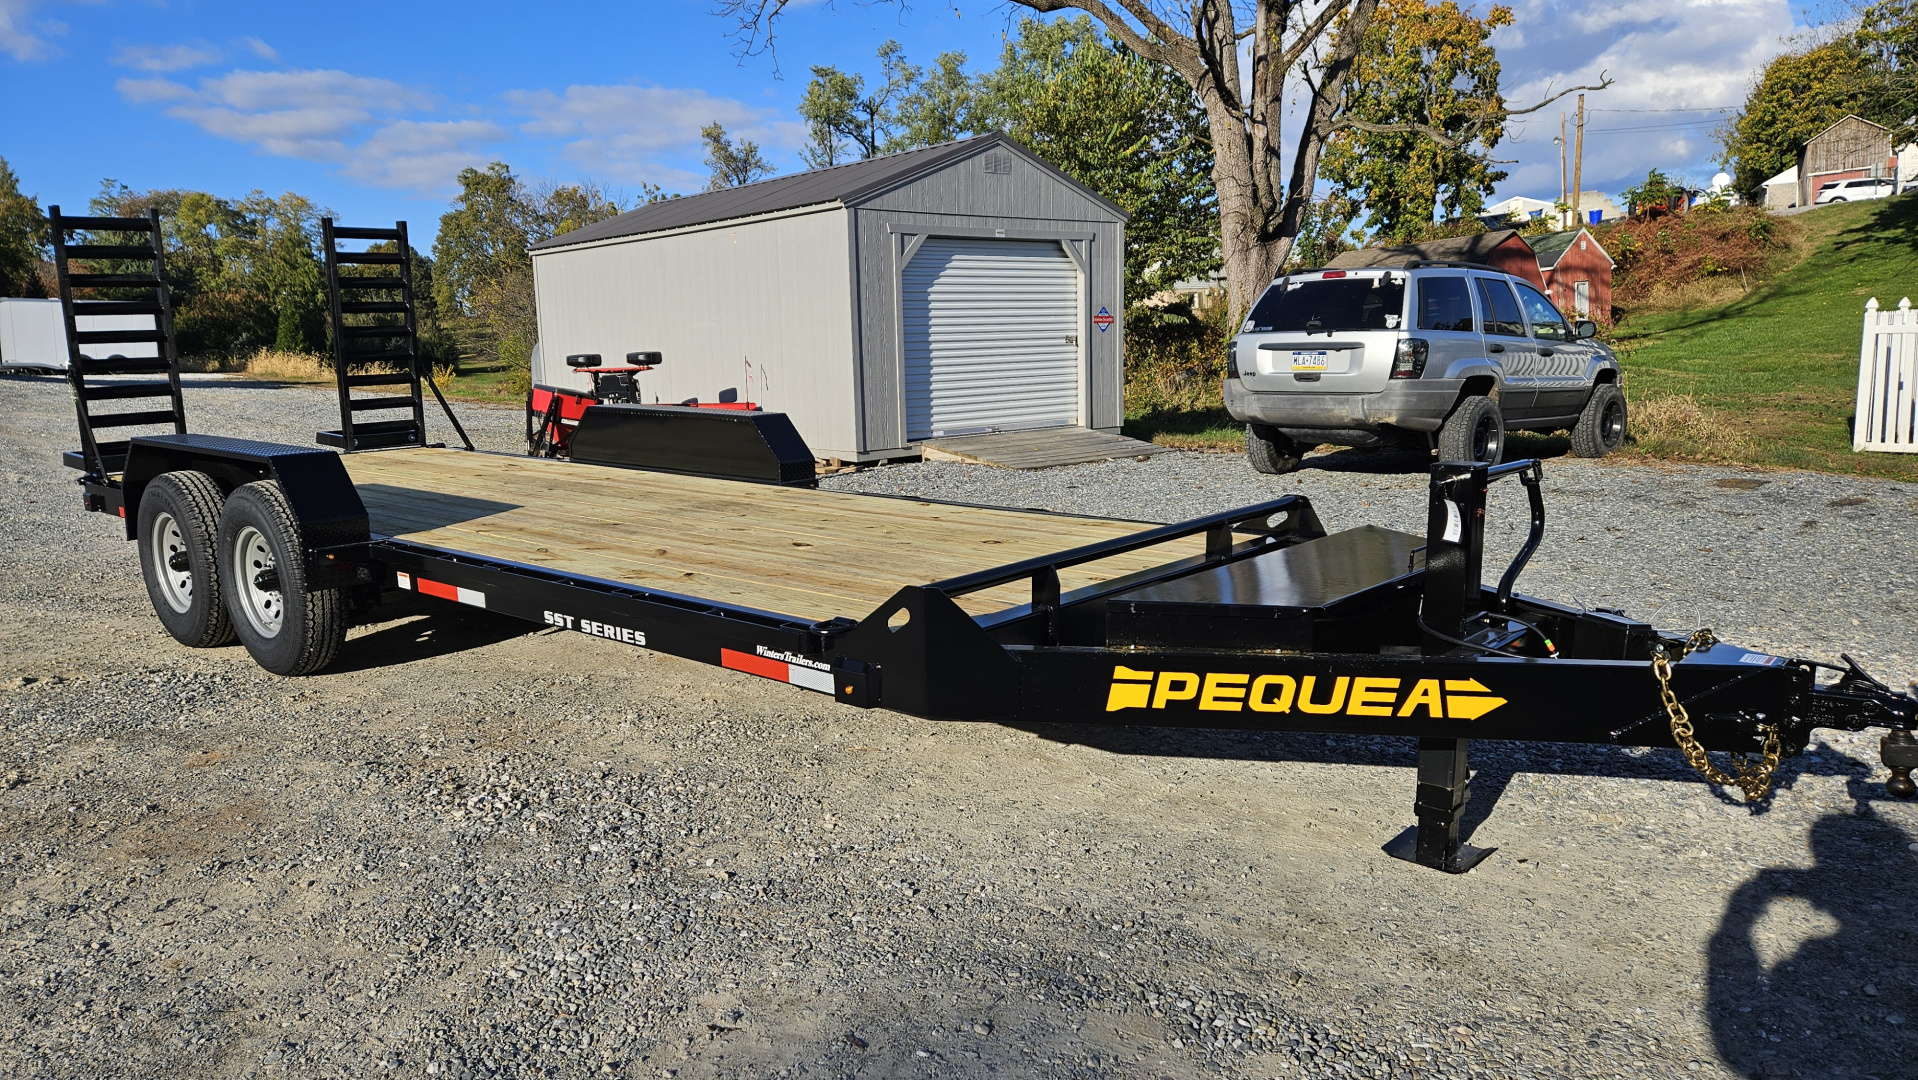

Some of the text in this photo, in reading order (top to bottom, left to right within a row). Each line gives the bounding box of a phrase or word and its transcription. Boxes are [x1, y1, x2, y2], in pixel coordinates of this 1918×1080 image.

[543, 610, 646, 646] SST SERIES
[756, 644, 831, 671] WintersTrailers.com
[1152, 671, 1444, 718] PEQUEA
